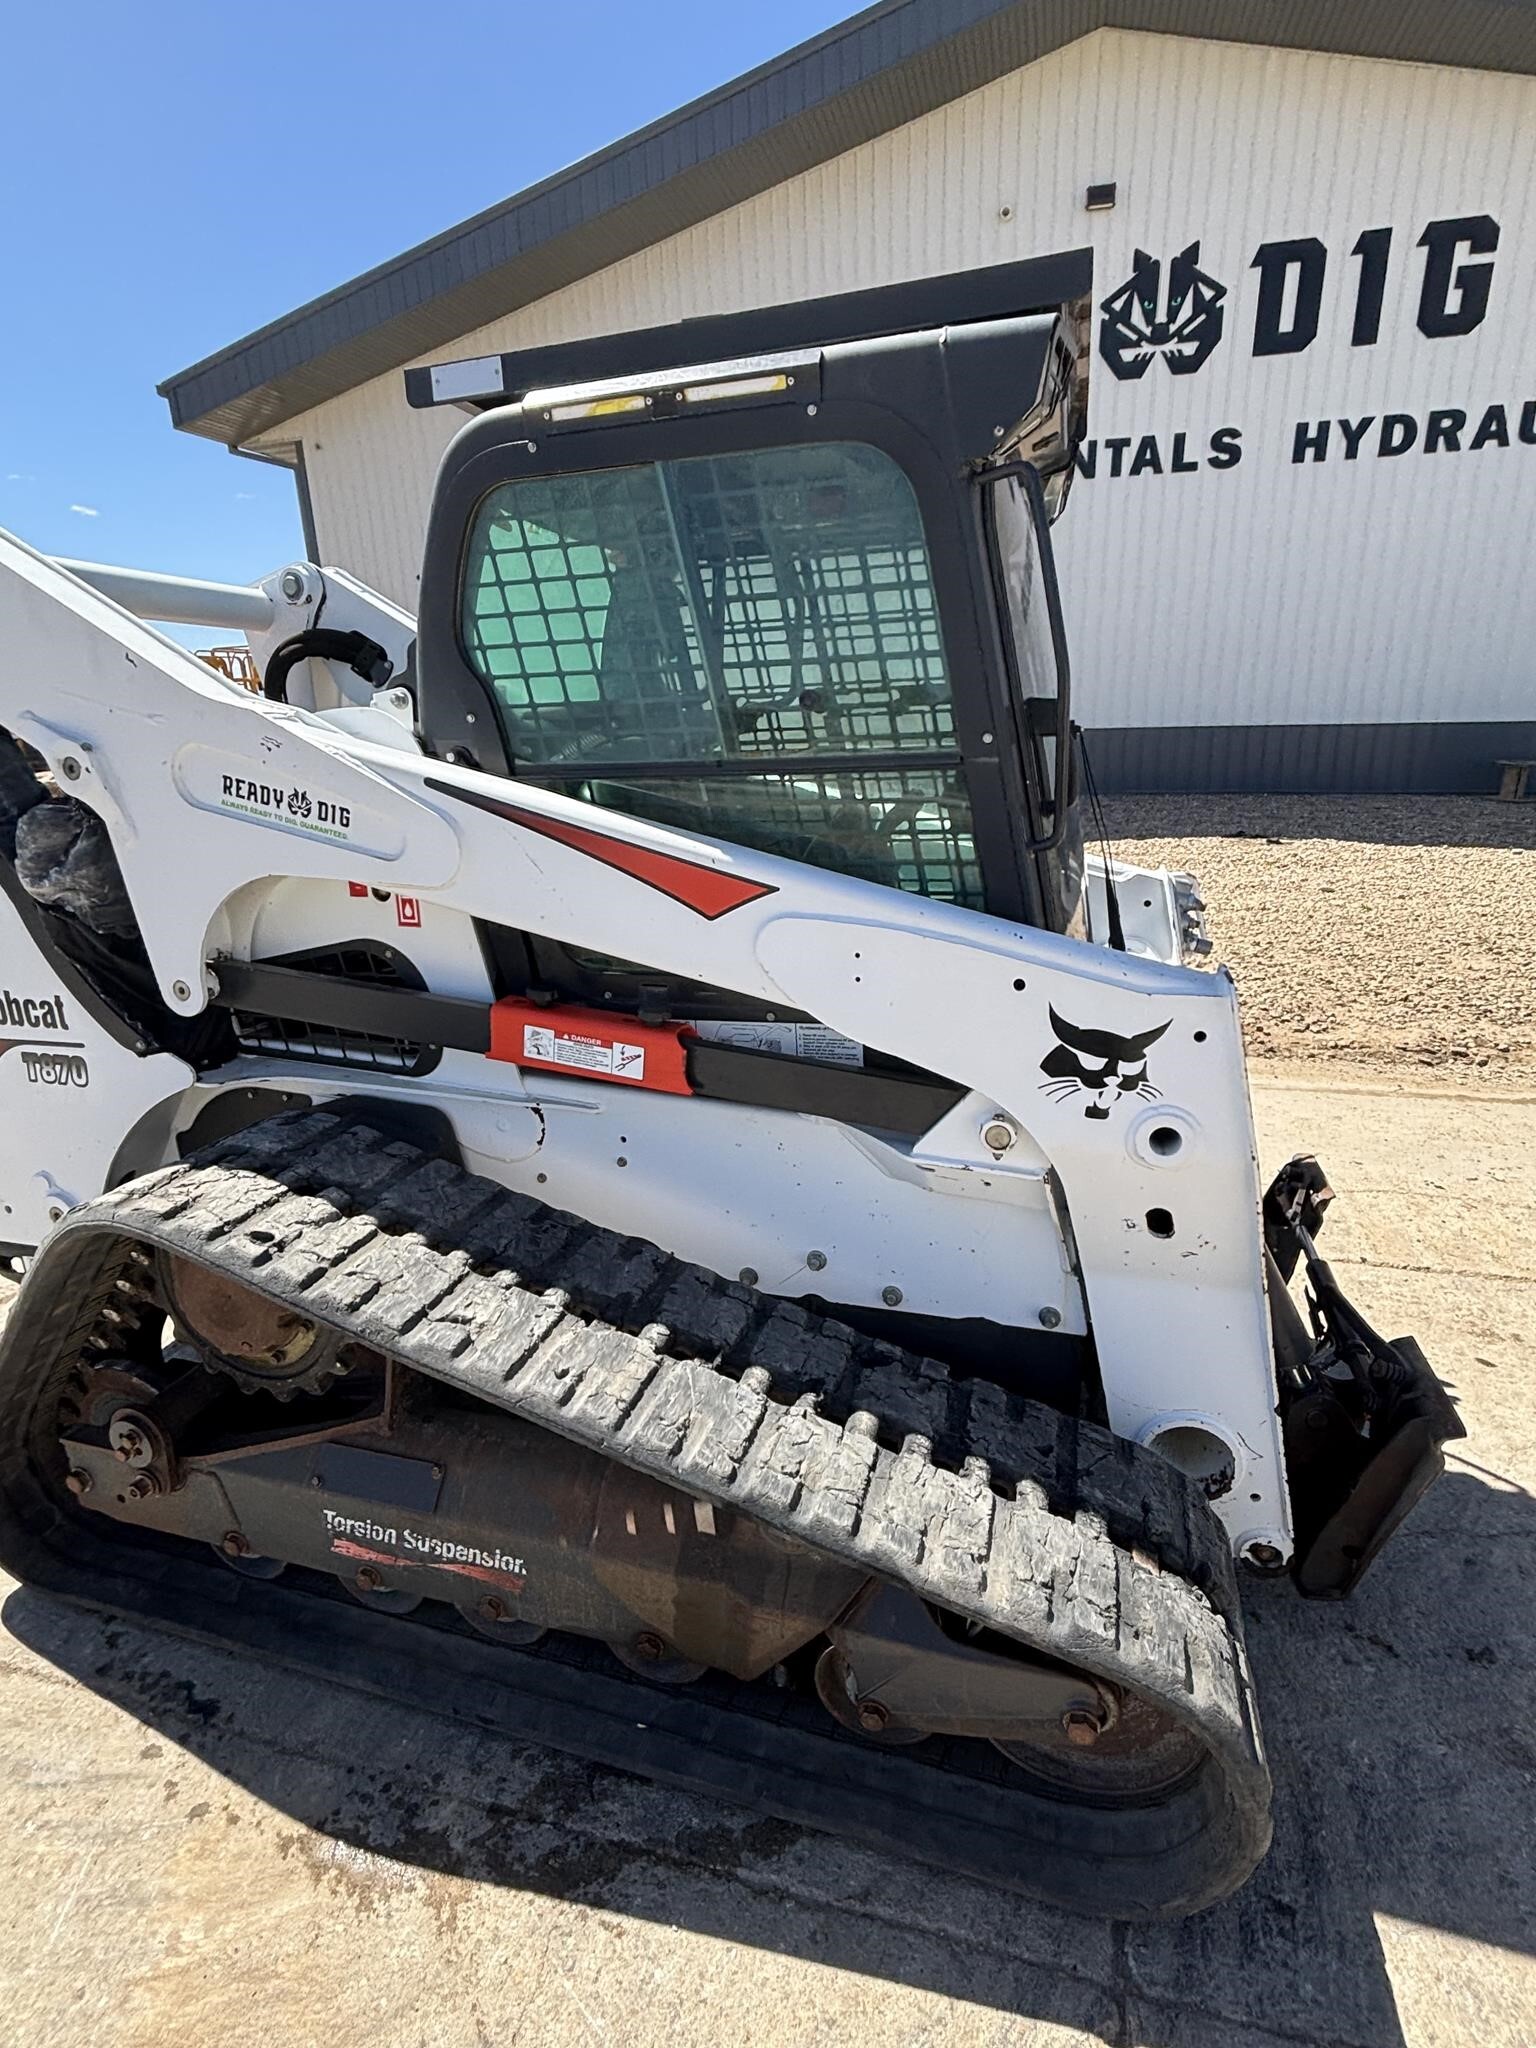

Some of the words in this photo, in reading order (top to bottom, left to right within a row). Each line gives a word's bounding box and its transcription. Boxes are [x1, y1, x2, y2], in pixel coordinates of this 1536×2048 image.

[221, 799, 249, 812] ALWAYS
[249, 807, 273, 818] READY
[274, 813, 283, 822] TO
[222, 774, 284, 809] READY
[317, 800, 351, 828] DIG
[571, 1034, 602, 1046] DANGER
[21, 1051, 89, 1088] T870
[323, 1509, 397, 1545] Torsion
[403, 1528, 527, 1575] Suspension
